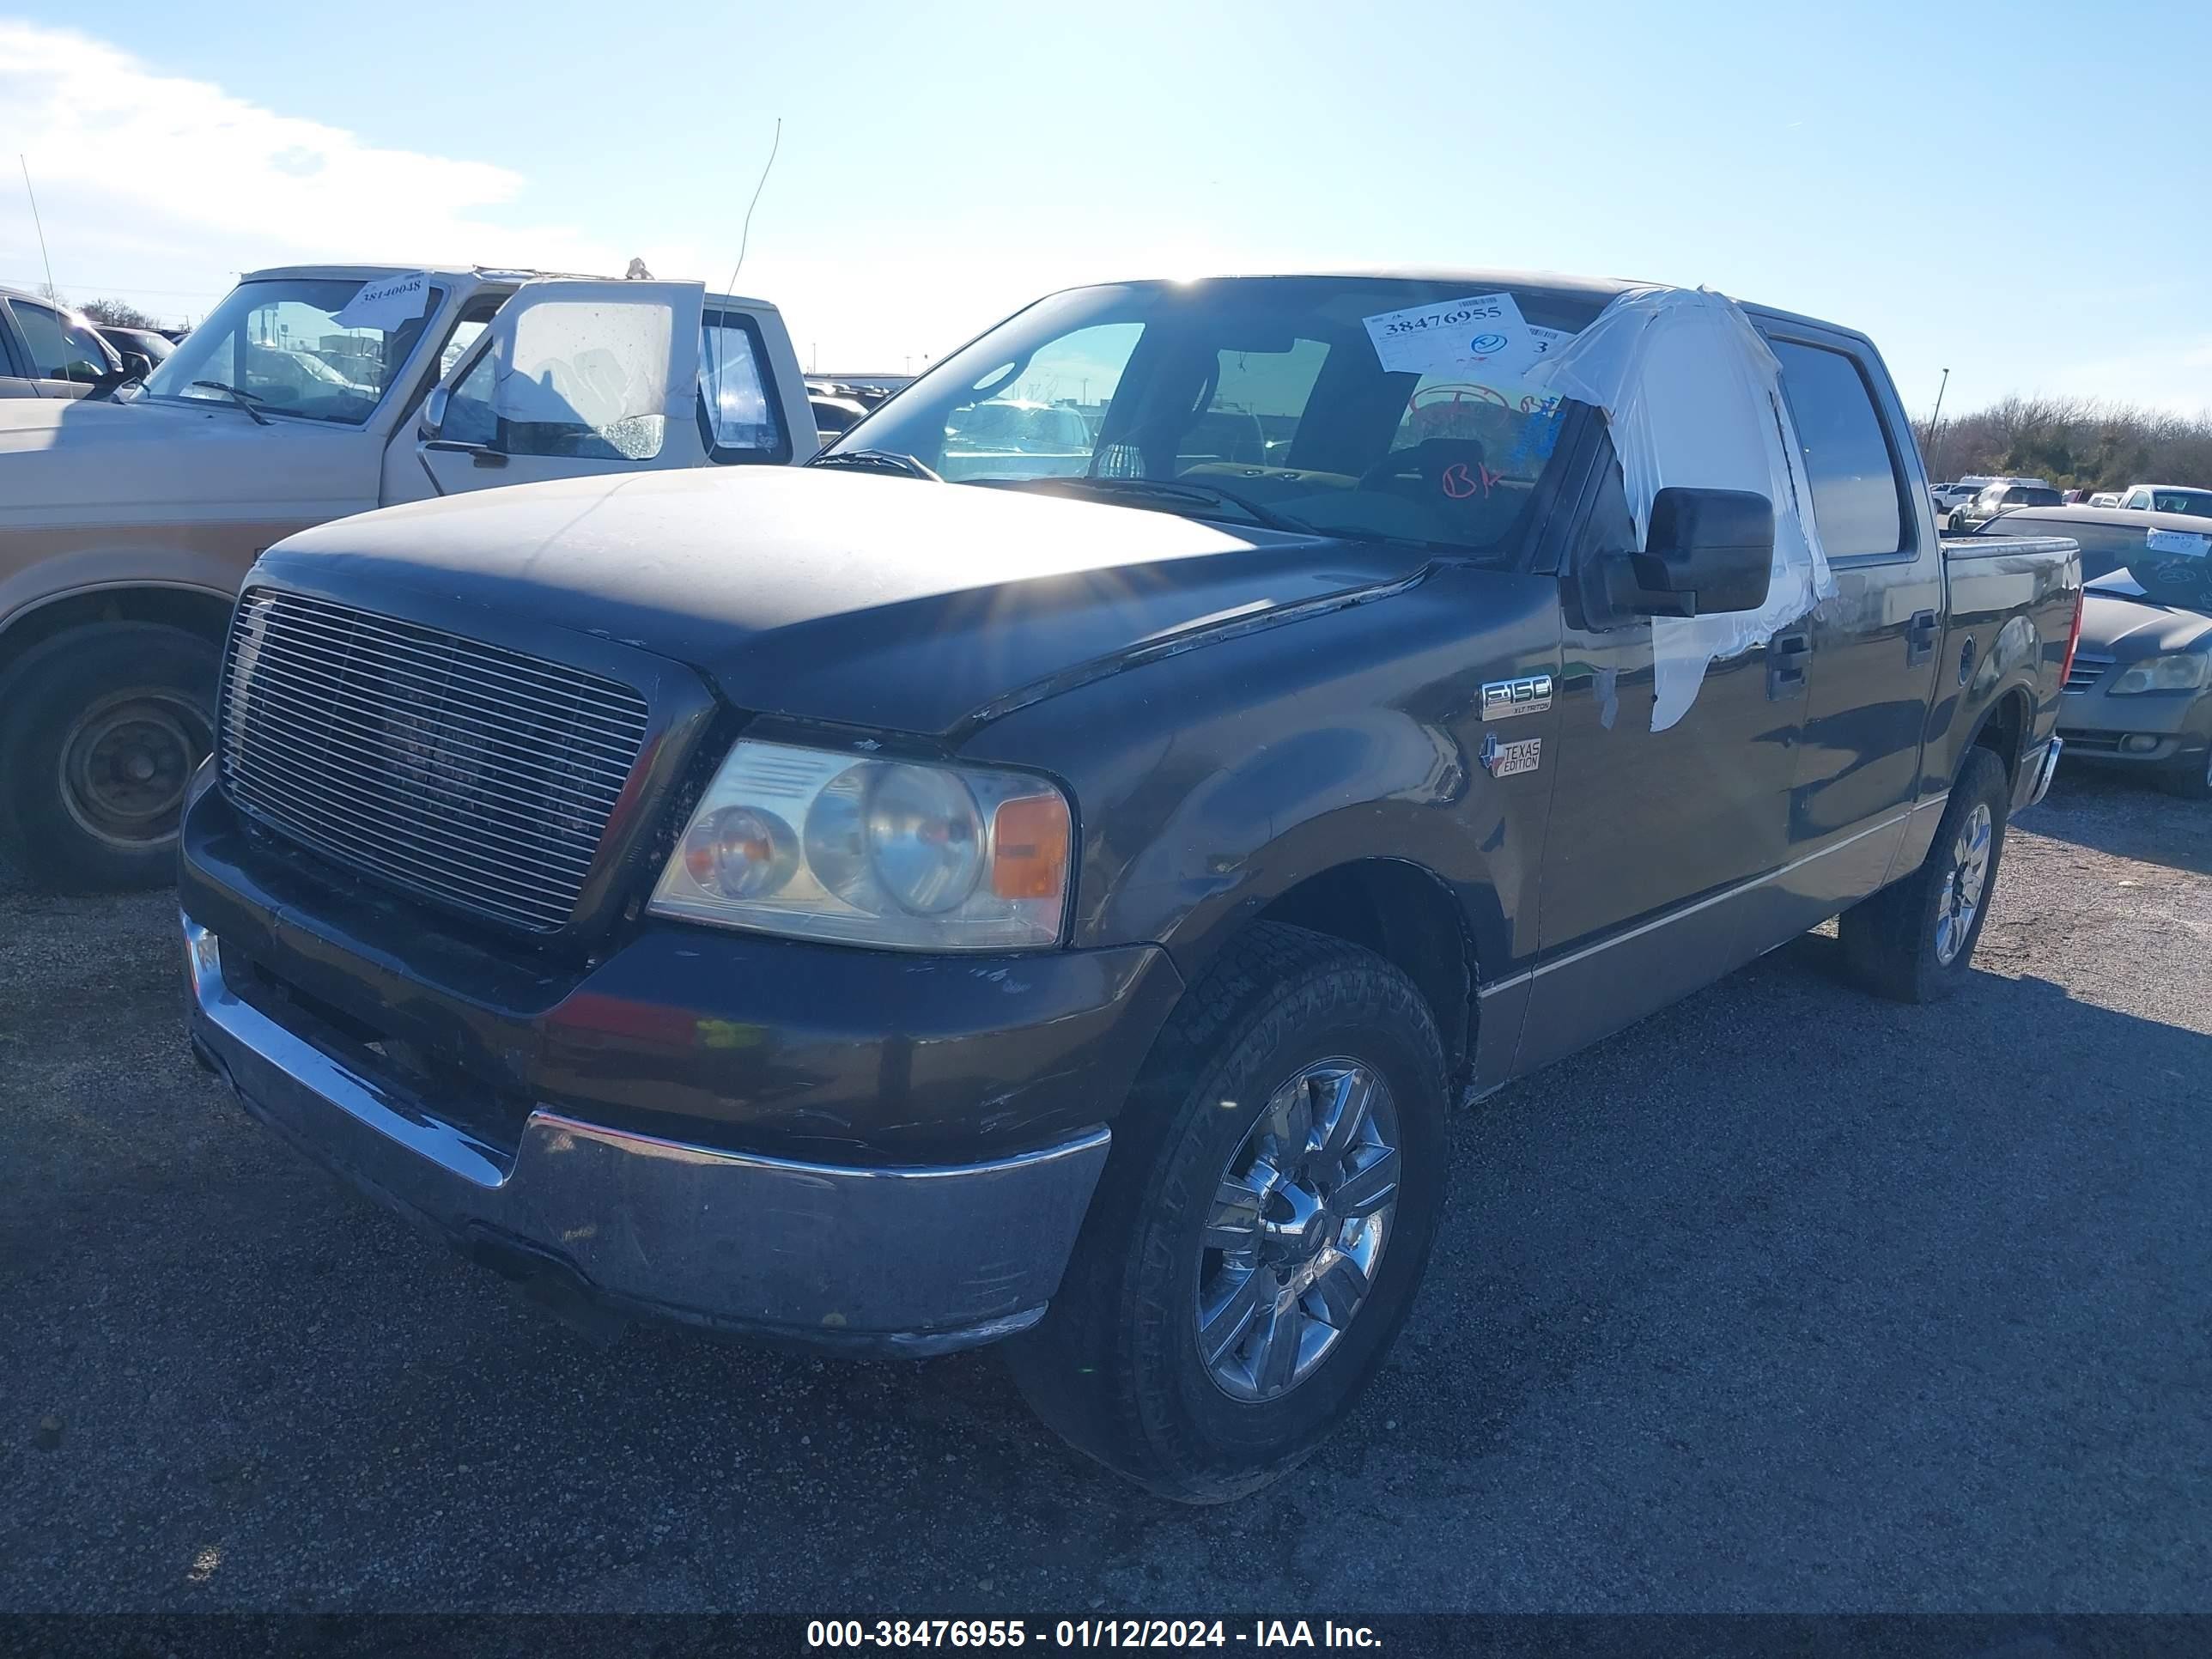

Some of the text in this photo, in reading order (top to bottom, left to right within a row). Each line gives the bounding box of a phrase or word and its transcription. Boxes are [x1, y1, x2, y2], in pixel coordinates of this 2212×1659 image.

[363, 280, 422, 301] 38140048
[1384, 306, 1502, 336] 38476955
[1505, 742, 1540, 761] TEXAS
[1504, 757, 1538, 773] EDITION
